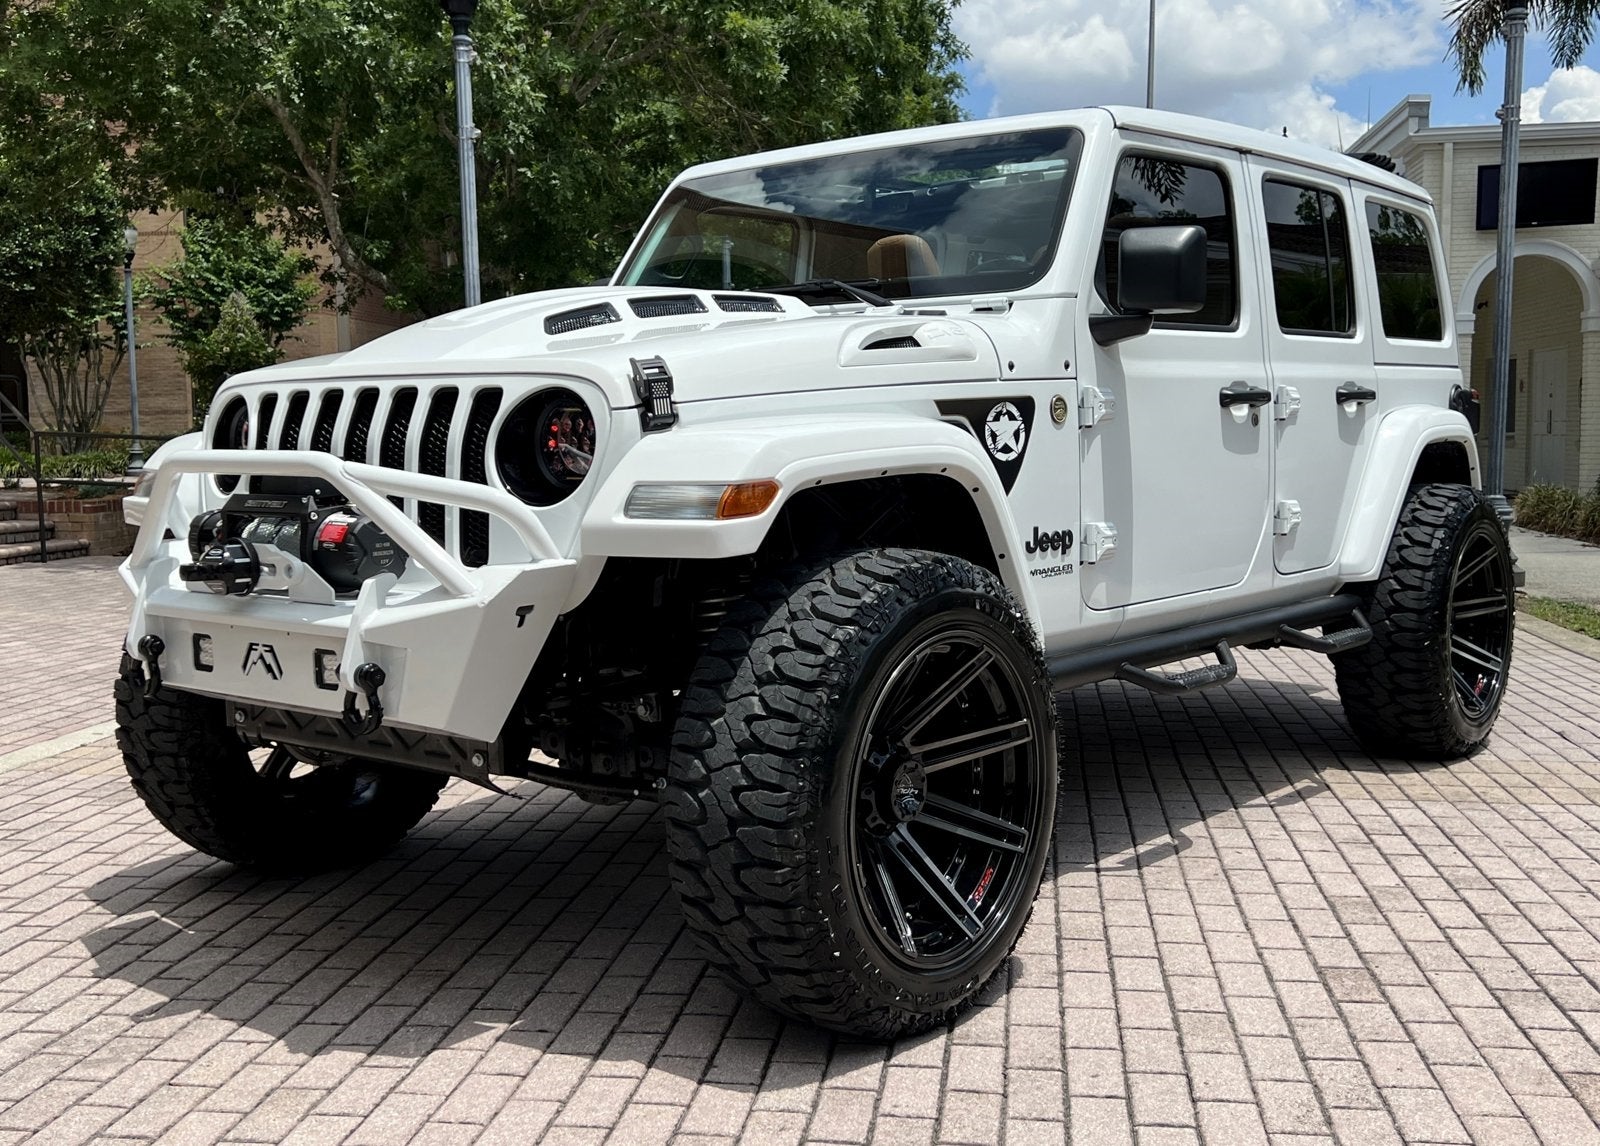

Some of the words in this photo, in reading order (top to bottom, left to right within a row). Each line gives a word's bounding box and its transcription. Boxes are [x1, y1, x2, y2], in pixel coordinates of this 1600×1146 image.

[1025, 526, 1074, 555] Jeep
[1029, 563, 1073, 577] WRANGLER
[1041, 569, 1074, 579] UNLIMITED
